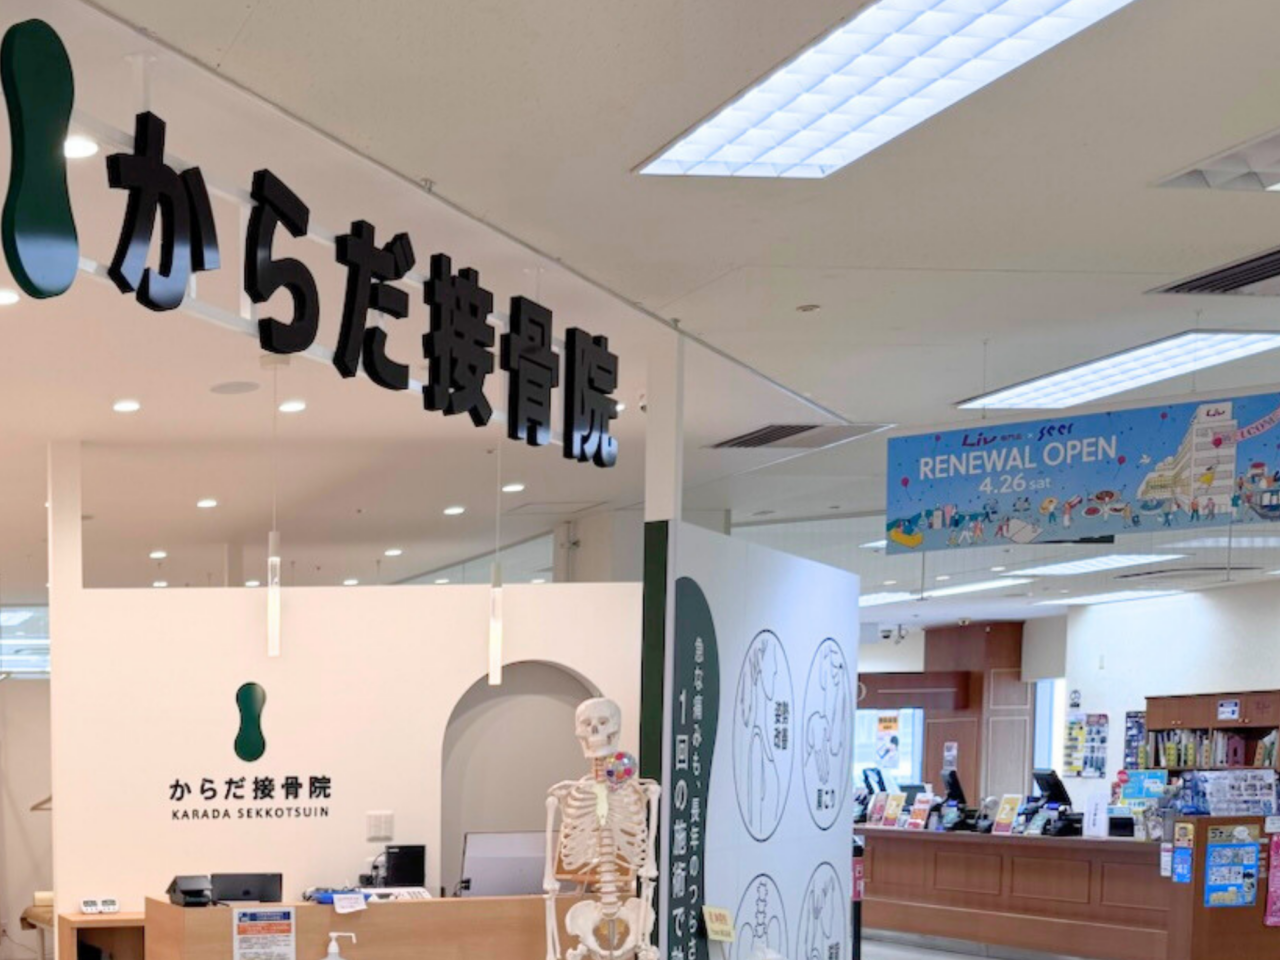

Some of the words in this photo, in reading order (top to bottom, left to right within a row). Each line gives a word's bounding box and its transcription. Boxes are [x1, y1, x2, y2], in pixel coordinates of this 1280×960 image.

[106, 111, 619, 468] からだ接骨院
[961, 432, 997, 447] Liv
[919, 445, 1037, 481] RENEWAL
[1042, 434, 1117, 467] OPEN
[979, 472, 1027, 495] 4.26
[1028, 477, 1052, 491] sat
[169, 775, 332, 801] からだ接骨院
[171, 808, 231, 820] KARADA
[237, 806, 329, 819] SEKKOTSUIN
